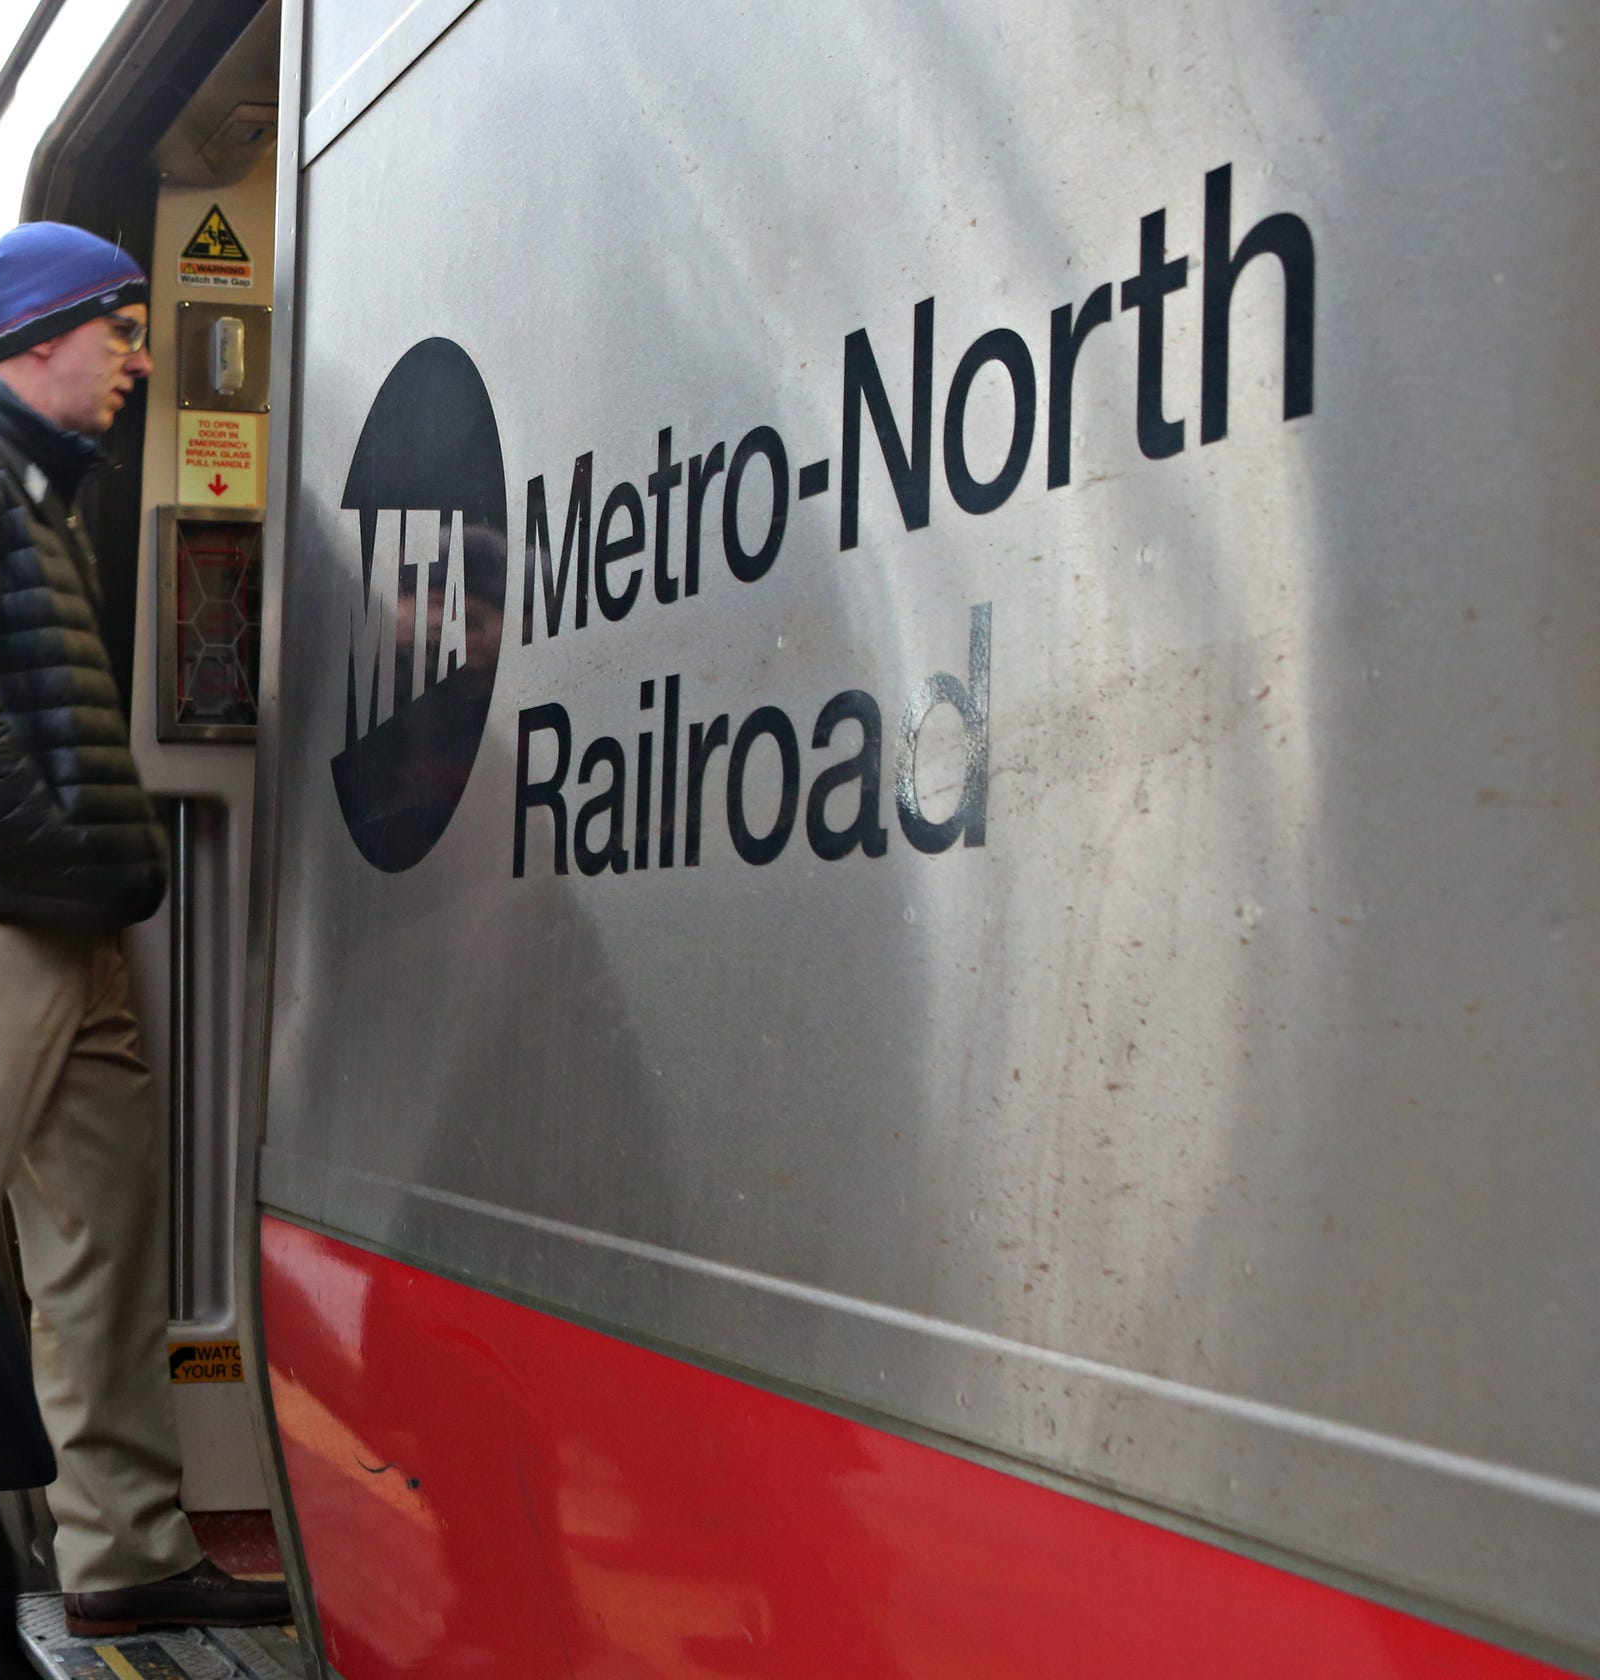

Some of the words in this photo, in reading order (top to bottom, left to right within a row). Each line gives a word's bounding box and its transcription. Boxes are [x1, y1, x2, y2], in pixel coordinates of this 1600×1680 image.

[197, 265, 245, 275] WARNING
[181, 275, 210, 283] Watch
[231, 278, 250, 287] Gap
[521, 161, 1315, 647] Metro-North
[198, 420, 211, 428] TO
[213, 421, 240, 429] OPEN
[199, 430, 226, 438] DOOR
[229, 431, 239, 439] IN
[189, 440, 248, 449] EMERGENCY
[185, 449, 217, 457] BREAK
[220, 451, 251, 459] GLASS
[186, 459, 209, 467] PULL
[212, 461, 250, 469] HANDLE
[333, 508, 468, 760] MTA
[512, 601, 992, 879] Railroad
[197, 1346, 241, 1360] WATC
[182, 1364, 226, 1378] YOUR
